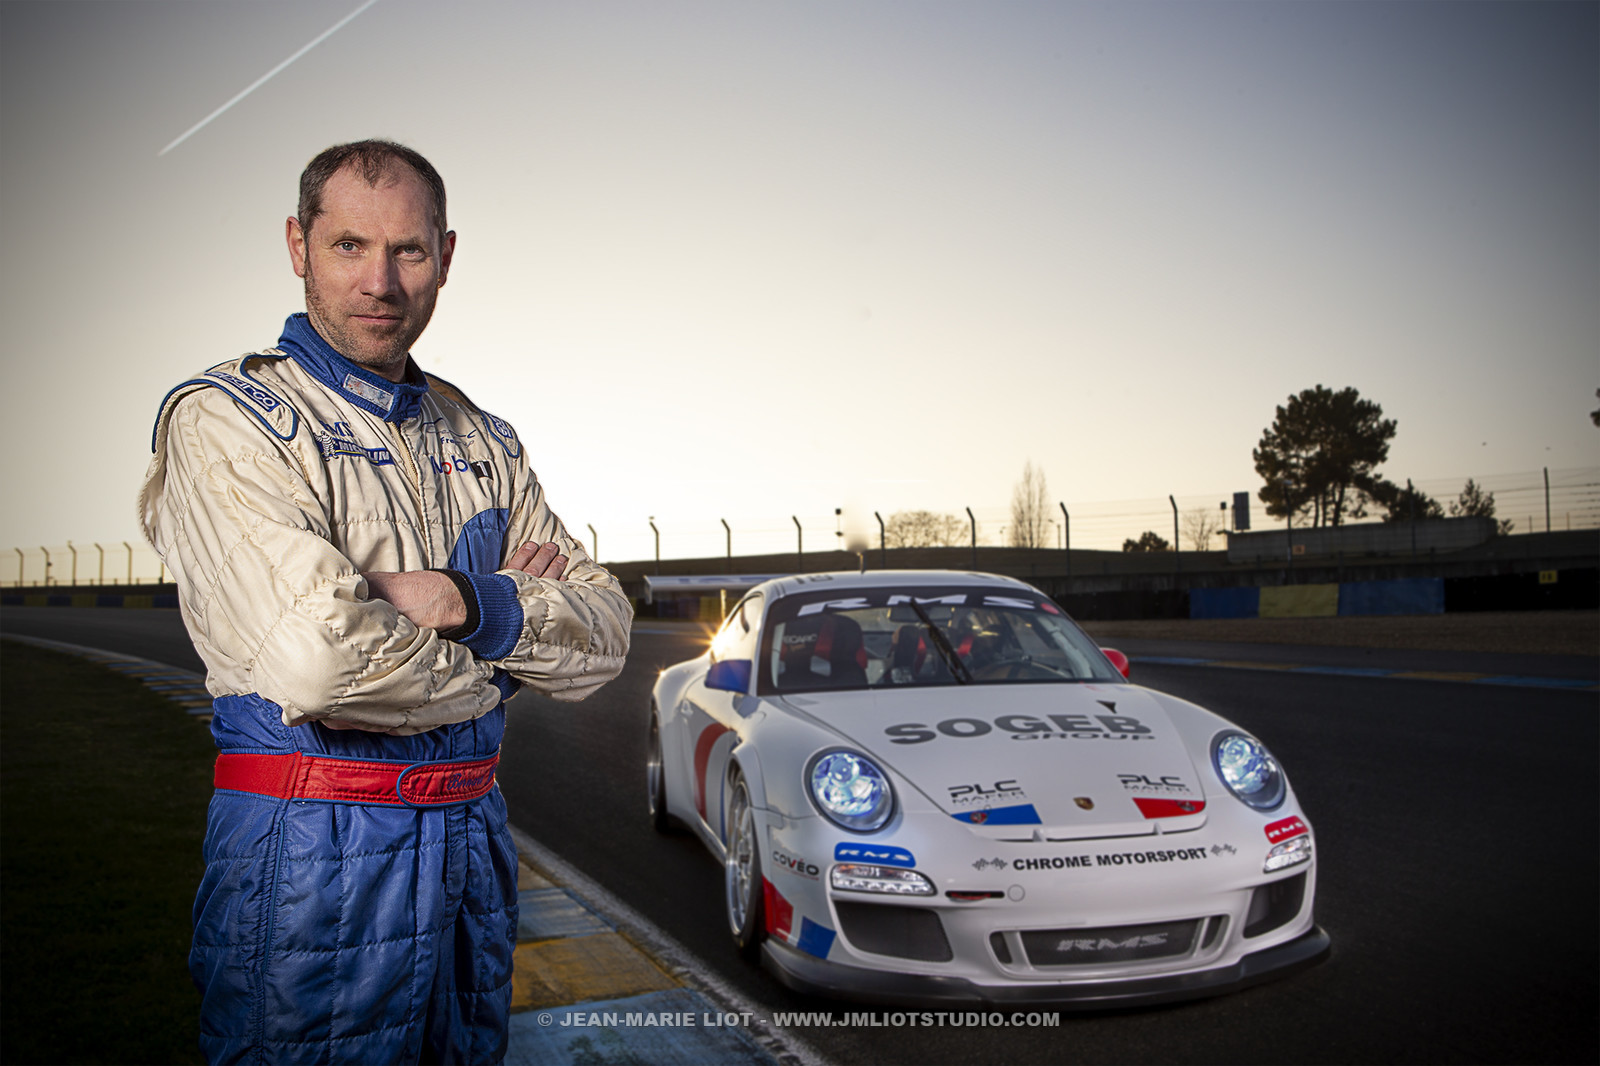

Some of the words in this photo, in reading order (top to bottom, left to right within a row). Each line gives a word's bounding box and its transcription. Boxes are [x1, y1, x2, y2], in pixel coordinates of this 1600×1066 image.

[338, 441, 390, 462] MICLIN
[797, 594, 1036, 617] RMS
[884, 713, 1152, 745] SOGEB
[1011, 732, 1156, 741] GROUP
[947, 780, 1021, 798] PLC
[1116, 774, 1187, 788] PLC
[838, 849, 912, 862] RMS
[1012, 854, 1092, 871] CHROME
[1096, 846, 1208, 868] MOTORSPORT
[1057, 932, 1169, 951] RMS
